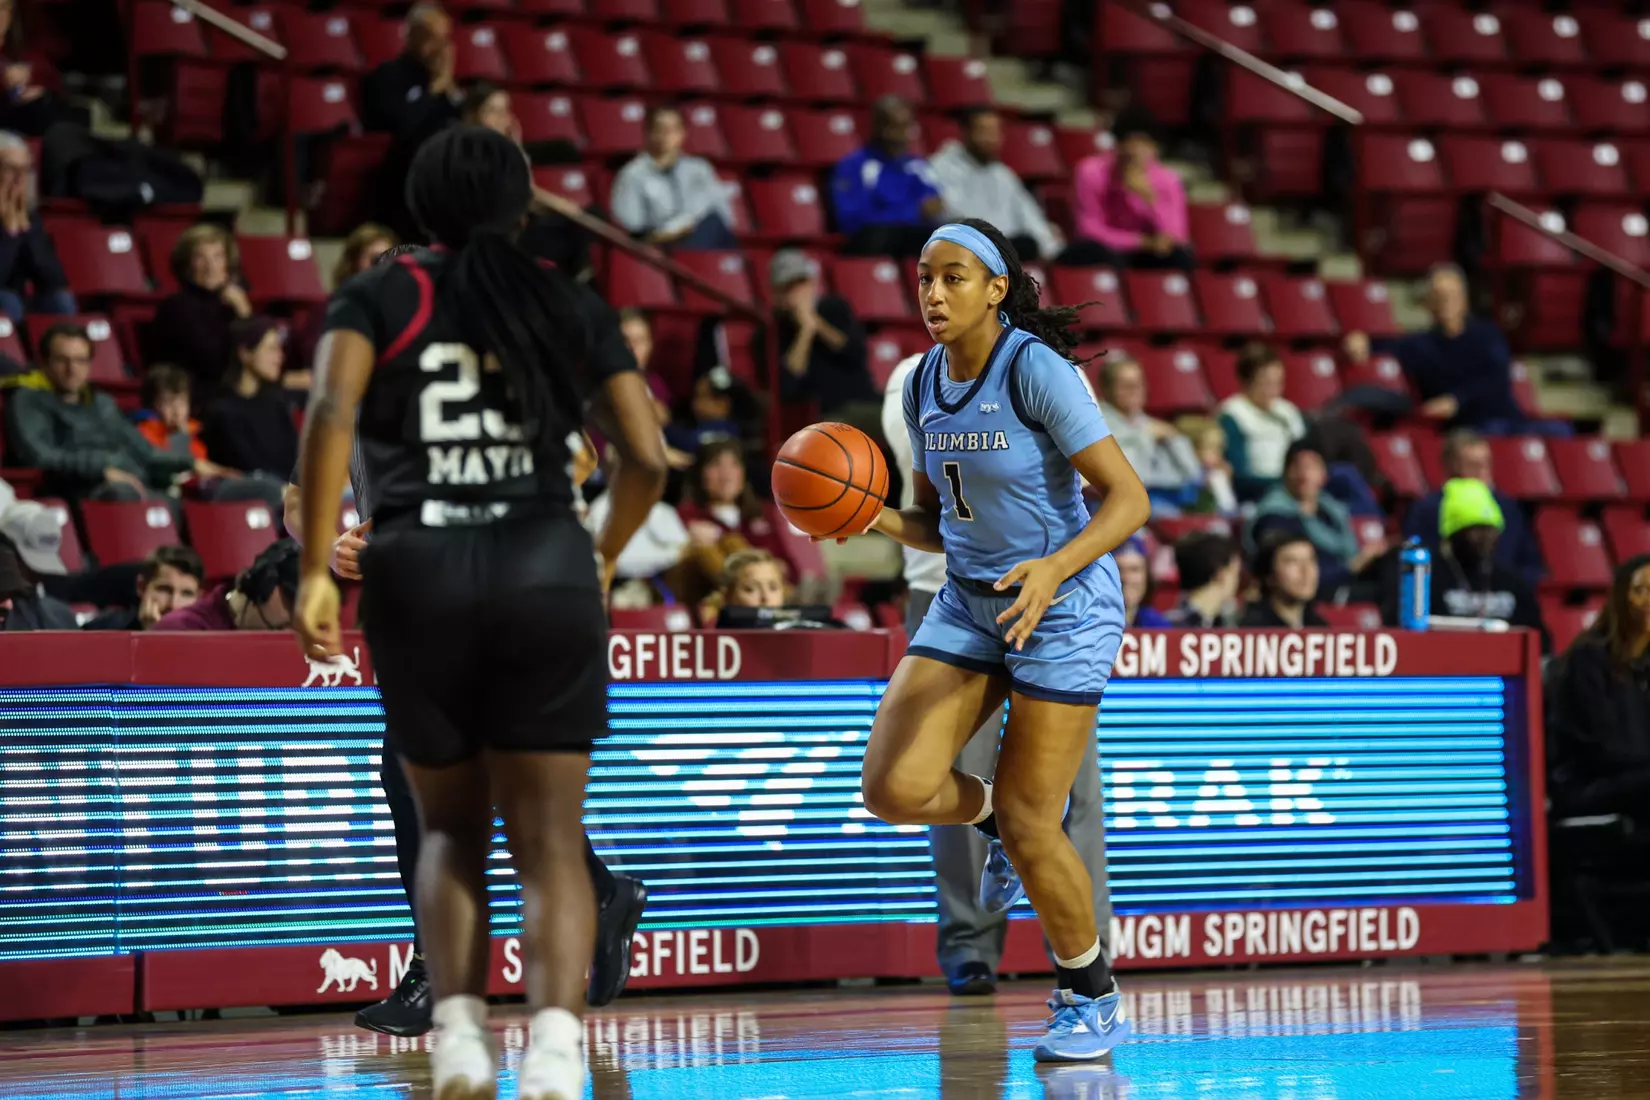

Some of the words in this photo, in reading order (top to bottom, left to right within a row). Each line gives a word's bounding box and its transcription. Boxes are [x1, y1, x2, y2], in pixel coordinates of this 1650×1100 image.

[925, 430, 1009, 452] LUMBIA
[942, 461, 974, 521] 1
[608, 634, 742, 680] GFIELD
[1115, 633, 1167, 677] GM
[1179, 632, 1398, 678] SPRINGFIELD
[1110, 914, 1191, 960] MGM
[1203, 907, 1420, 957] SPRINGFIELD
